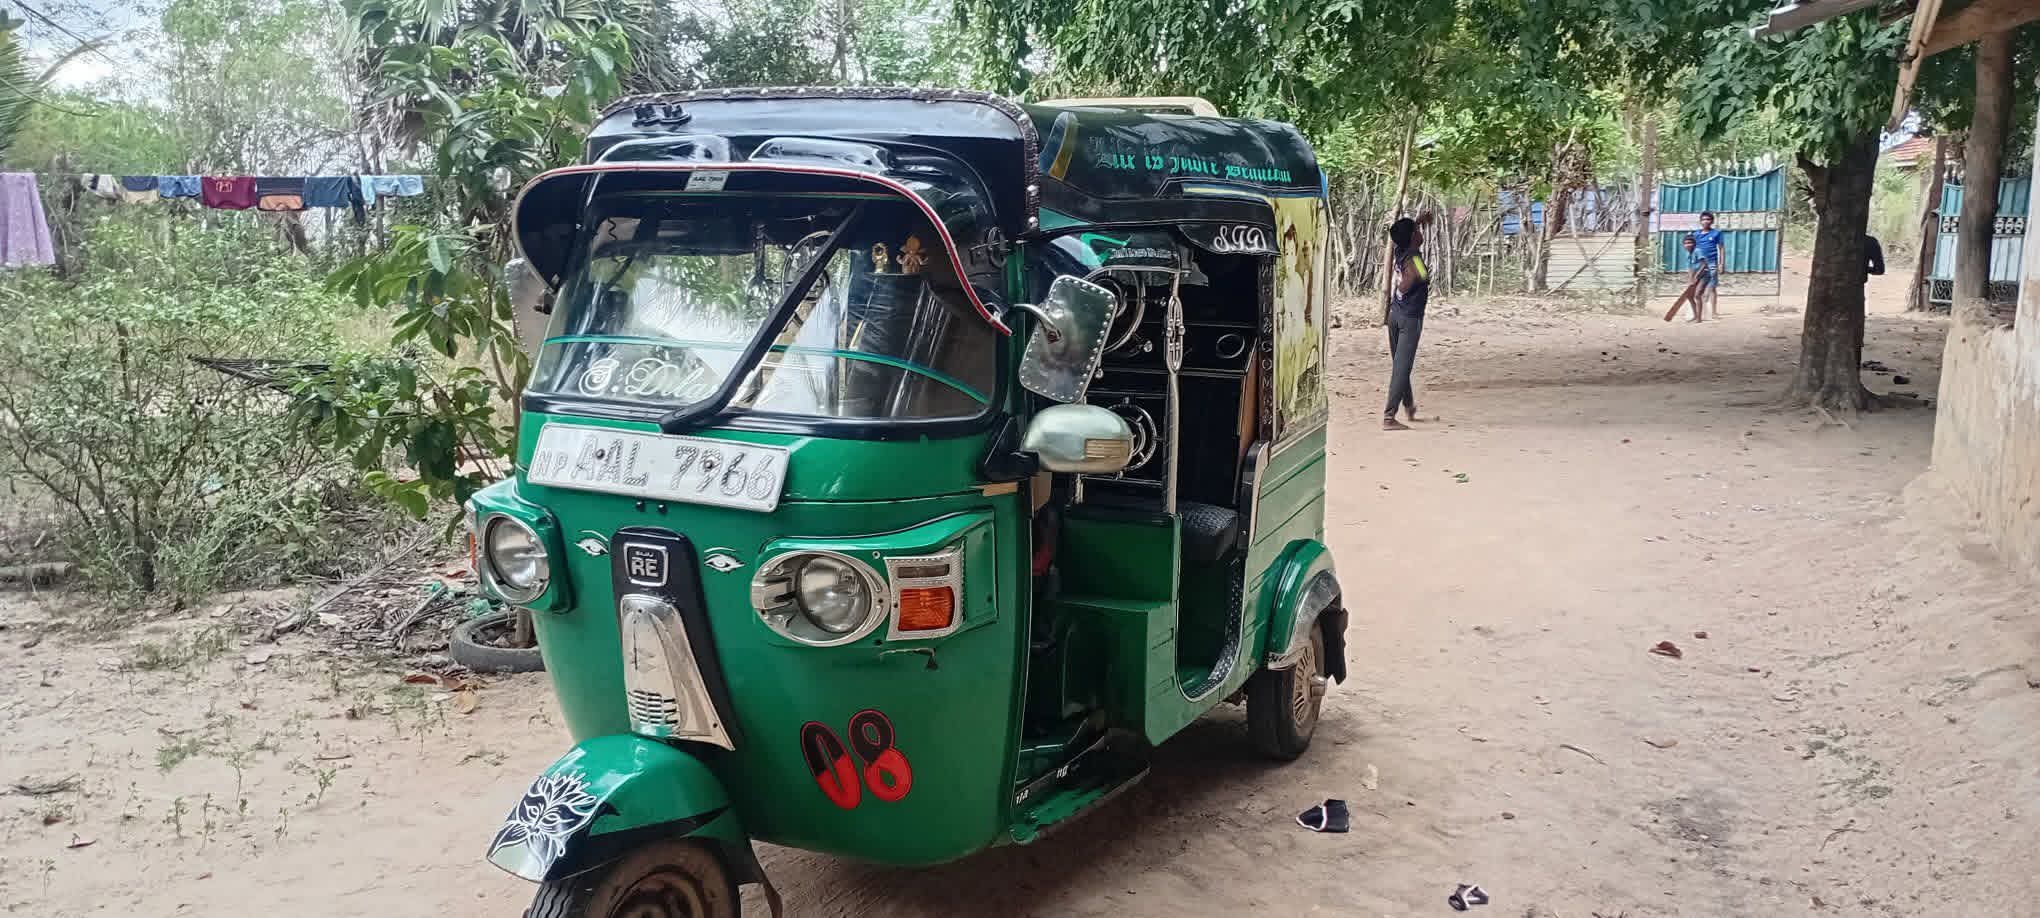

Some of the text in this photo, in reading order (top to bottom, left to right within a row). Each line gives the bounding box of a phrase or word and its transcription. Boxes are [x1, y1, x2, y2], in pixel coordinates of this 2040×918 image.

[535, 434, 776, 500] NP AAL 7966
[631, 556, 659, 578] RE
[800, 708, 913, 810] 08
